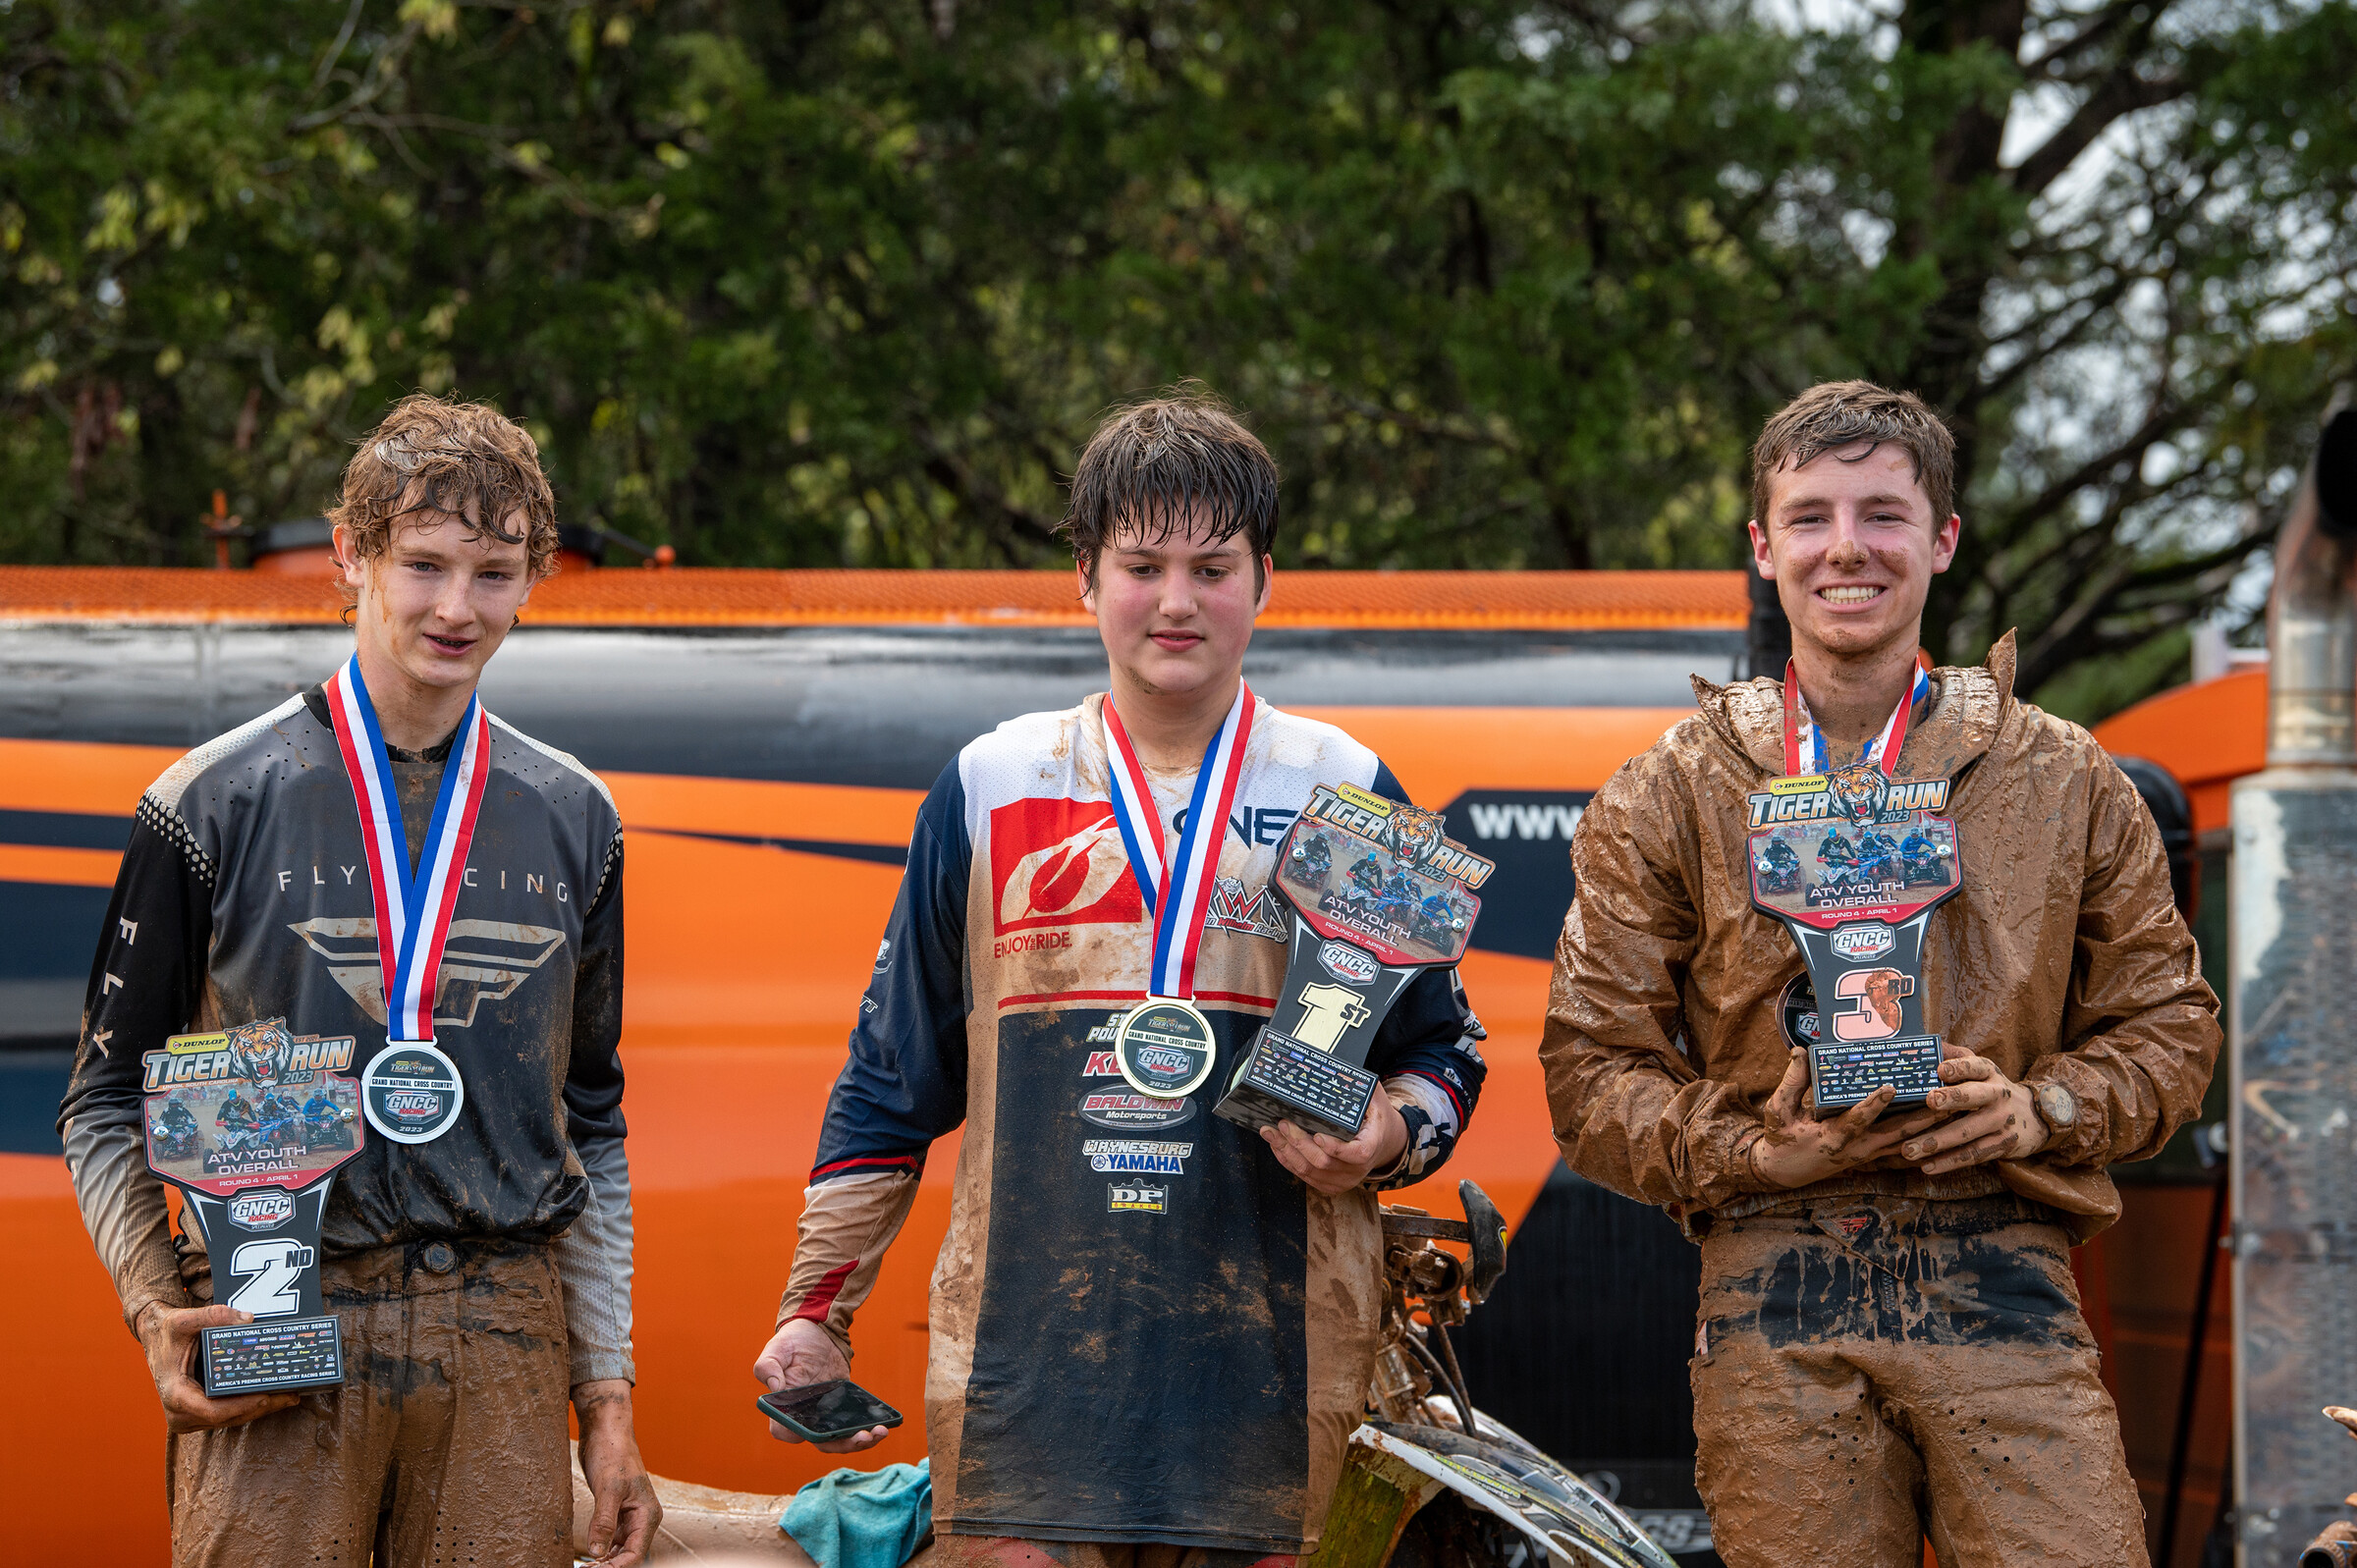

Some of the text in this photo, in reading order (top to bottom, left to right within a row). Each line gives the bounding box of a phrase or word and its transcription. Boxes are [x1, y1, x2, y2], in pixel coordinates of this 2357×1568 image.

[1784, 780, 1825, 788] DUNLOP
[1350, 792, 1389, 811] DUNLOP
[1749, 783, 1946, 827] TIGER RUN
[1880, 811, 1910, 823] 2023
[1305, 786, 1491, 886] TIGER RUN
[278, 866, 356, 892] FLY
[1417, 863, 1448, 882] 2023
[1810, 881, 1905, 897] ATV YOUTH
[1821, 894, 1898, 908] OVERALL
[1325, 895, 1412, 940] ATV YOUTH
[1218, 917, 1255, 931] Wilhelm
[1255, 923, 1288, 940] Racing
[1330, 909, 1398, 946] OVERALL
[995, 935, 1031, 958] ENJOY
[1036, 932, 1072, 949] RIDE.
[1325, 922, 1354, 938] ROUND
[1365, 940, 1388, 953] APRIL
[1836, 932, 1890, 947] GNCC
[1324, 947, 1374, 975] GNCC
[1333, 963, 1360, 978] RACING
[93, 916, 138, 1059] FLY
[183, 1039, 226, 1048] DUNLOP
[1145, 1034, 1167, 1044] NATIONAL
[1169, 1037, 1183, 1047] CROSS
[1184, 1040, 1206, 1050] COUNTRY
[1139, 1051, 1188, 1068] GNCC
[1267, 1033, 1285, 1044] GRAND
[1285, 1041, 1310, 1056] NATIONAL
[1310, 1052, 1328, 1063] CROSS
[1328, 1060, 1352, 1074] COUNTRY
[146, 1040, 352, 1088] TIGER RUN
[1149, 1063, 1177, 1073] RACING
[282, 1071, 313, 1084] 2023
[388, 1096, 436, 1109] GNCC
[1082, 1095, 1186, 1111] BALDWIN
[1290, 1092, 1305, 1102] CROSS
[1305, 1098, 1325, 1110] COUNTRY
[1105, 1110, 1167, 1120] Motorsports
[207, 1146, 307, 1164] ATV YOUTH
[1082, 1140, 1193, 1157] WAYNESBURG
[218, 1160, 299, 1175] OVERALL
[1108, 1155, 1180, 1171] YAMAHA
[219, 1178, 252, 1187] ROUND
[1112, 1189, 1164, 1203] DP
[234, 1199, 290, 1217] GNCC
[247, 1214, 278, 1222] RACING
[228, 1238, 313, 1319] 2ND
